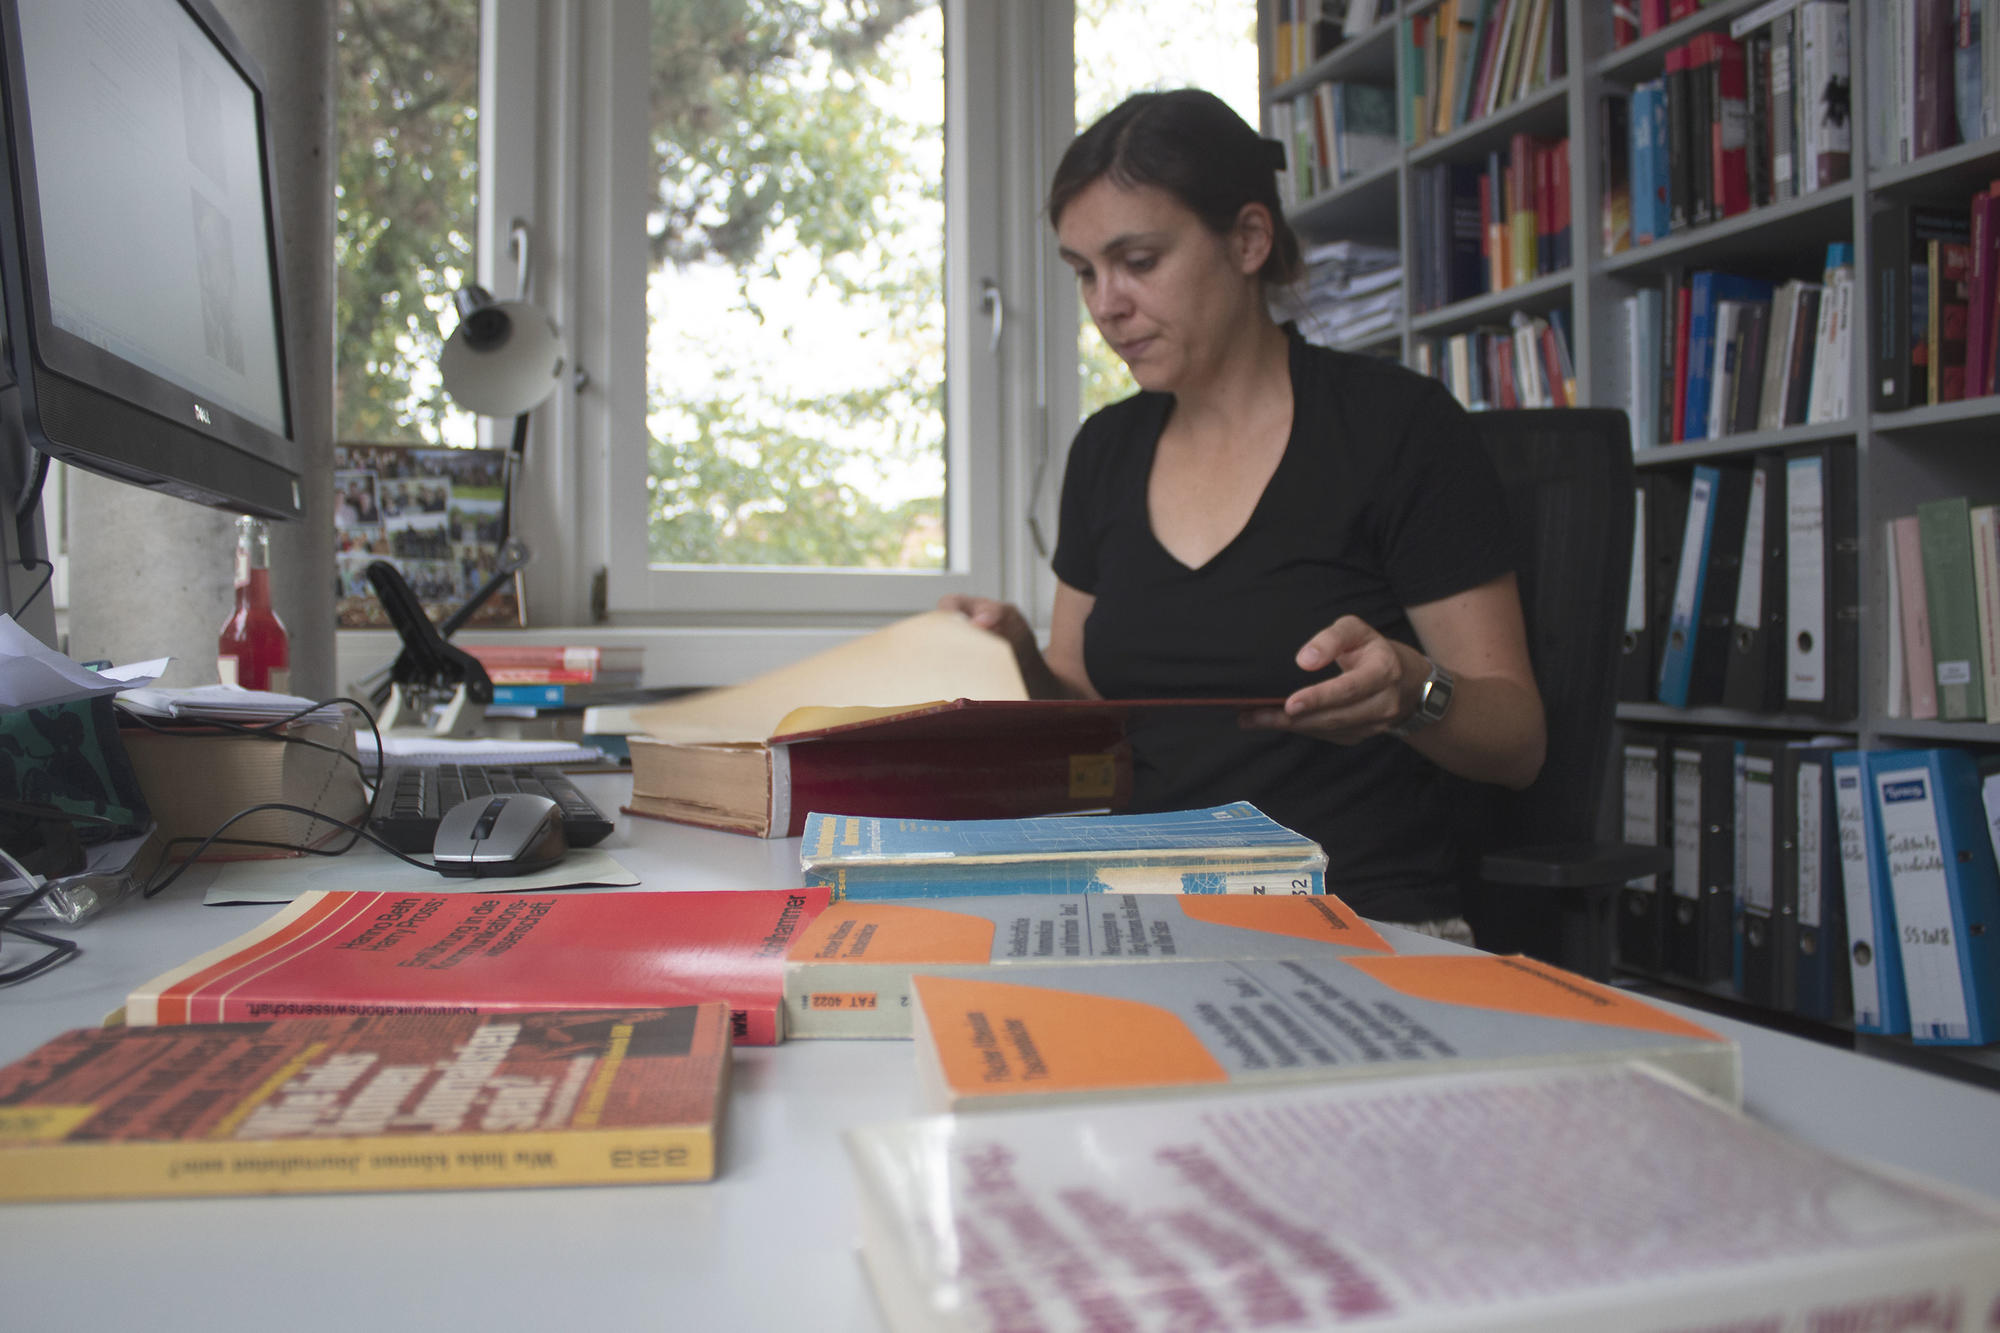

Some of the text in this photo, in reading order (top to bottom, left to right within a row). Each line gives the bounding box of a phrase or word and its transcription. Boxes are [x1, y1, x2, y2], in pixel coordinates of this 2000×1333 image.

[334, 898, 422, 950] Hanno Beth
[364, 897, 448, 952] Harry Pross:
[396, 900, 501, 967] Einführung in die
[813, 996, 842, 1008] 4022
[849, 996, 877, 1008] FAT
[456, 1152, 504, 1172] links
[514, 1151, 556, 1171] Wie
